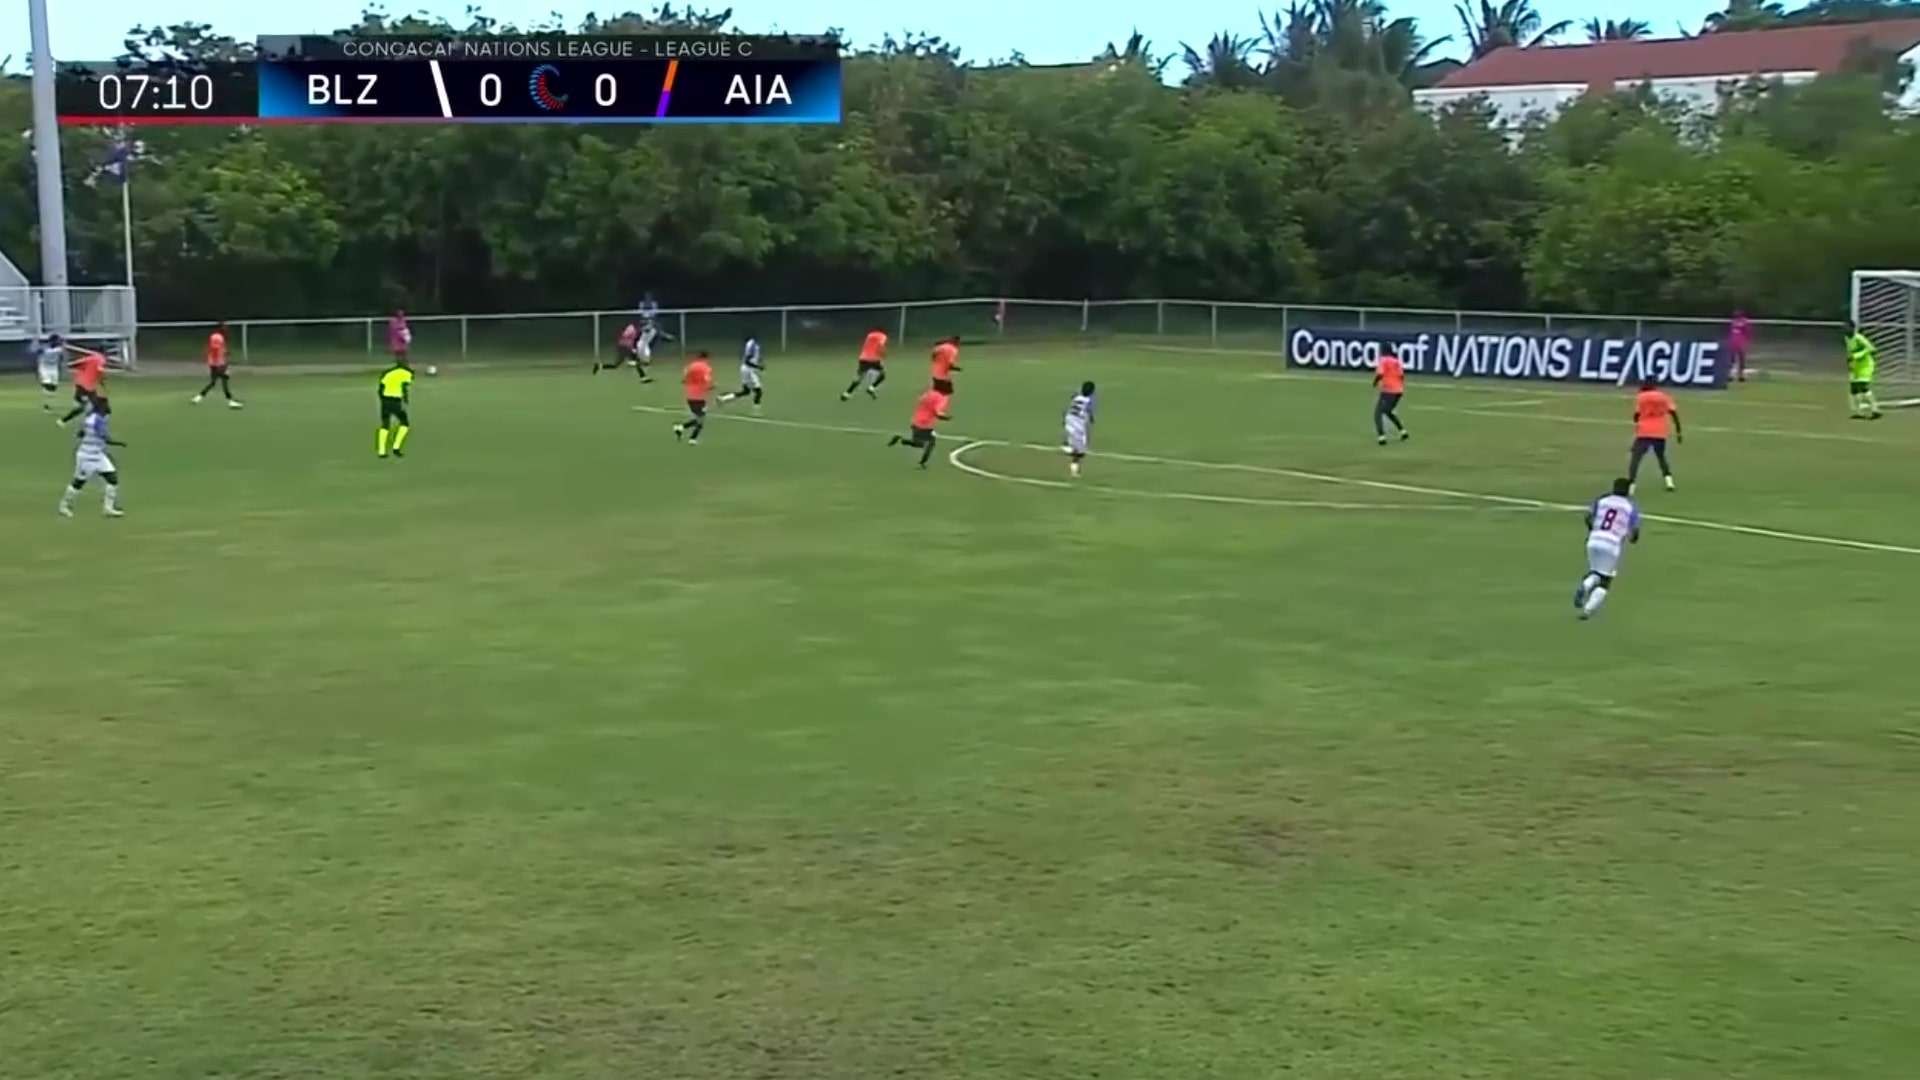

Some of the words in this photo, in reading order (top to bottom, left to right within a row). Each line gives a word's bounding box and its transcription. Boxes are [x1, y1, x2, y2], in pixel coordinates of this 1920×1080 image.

[1291, 329, 1430, 371] Concaaf
[1434, 334, 1573, 378] NATIONS
[1579, 338, 1719, 387] LEAGUE
[1600, 508, 1618, 531] 8
